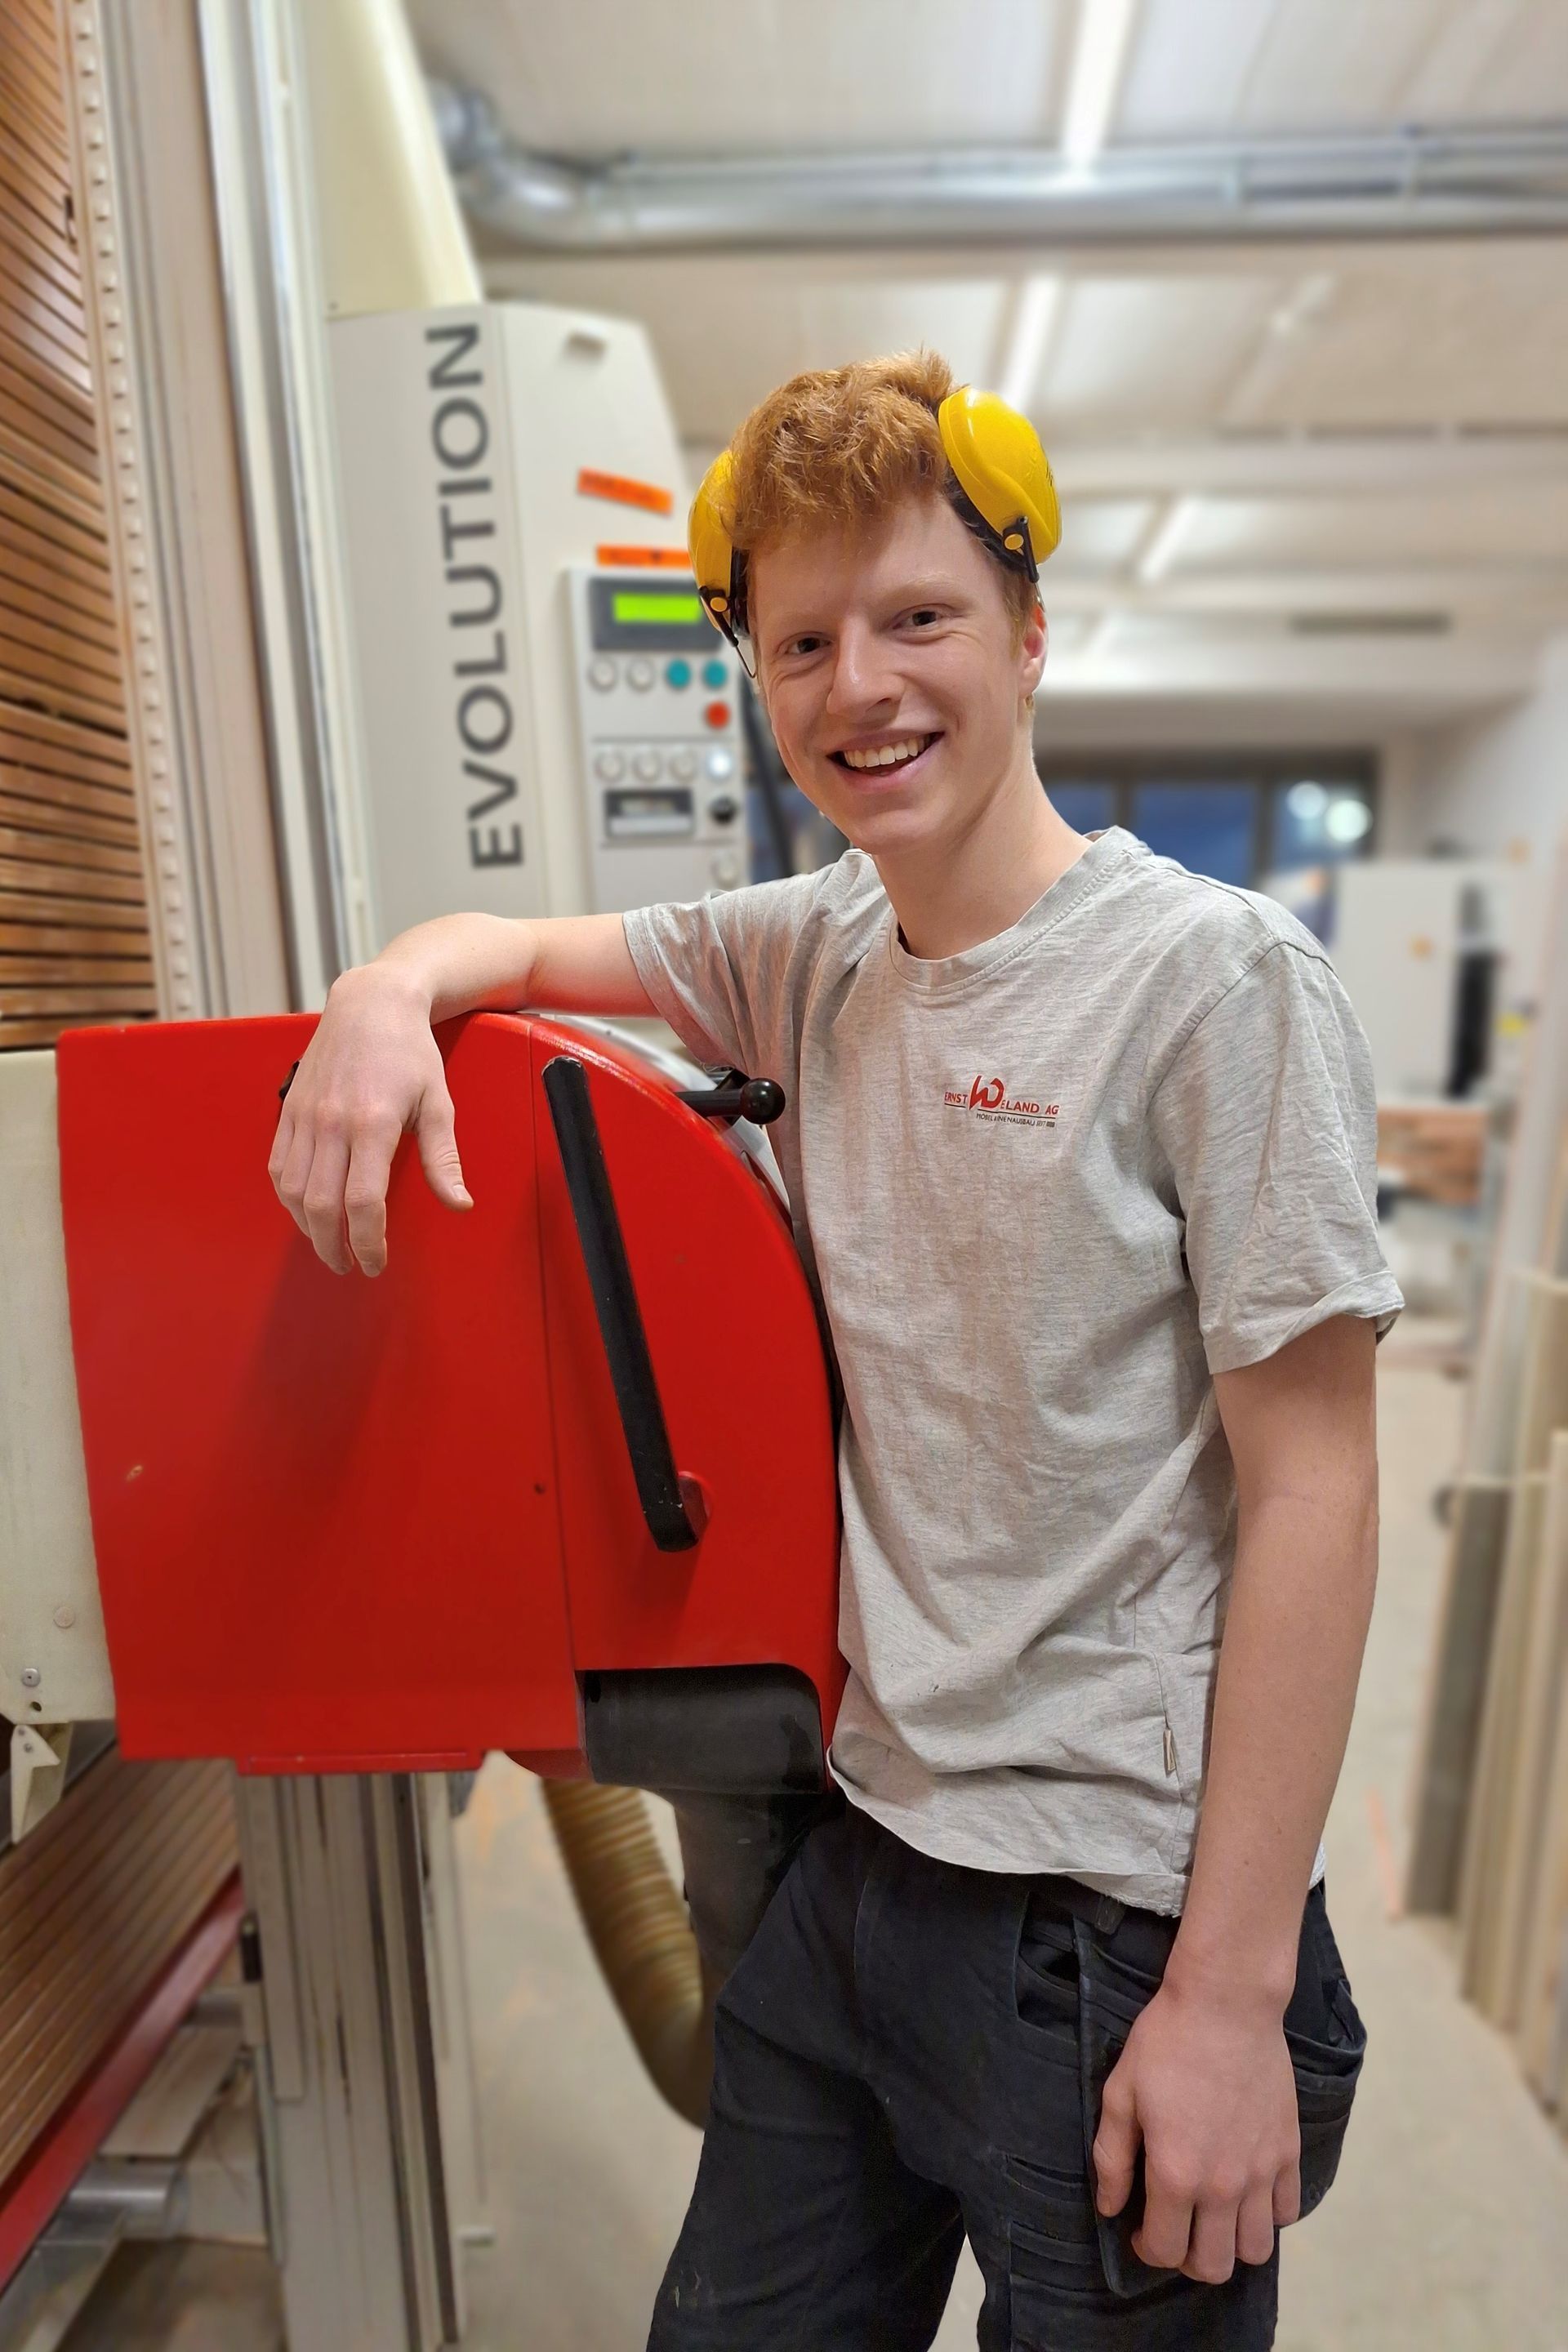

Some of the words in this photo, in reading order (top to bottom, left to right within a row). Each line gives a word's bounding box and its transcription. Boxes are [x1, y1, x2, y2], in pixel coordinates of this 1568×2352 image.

[425, 323, 523, 870] EVOLUTION
[944, 1091, 969, 1105] ERNST
[1045, 1104, 1060, 1116] AG
